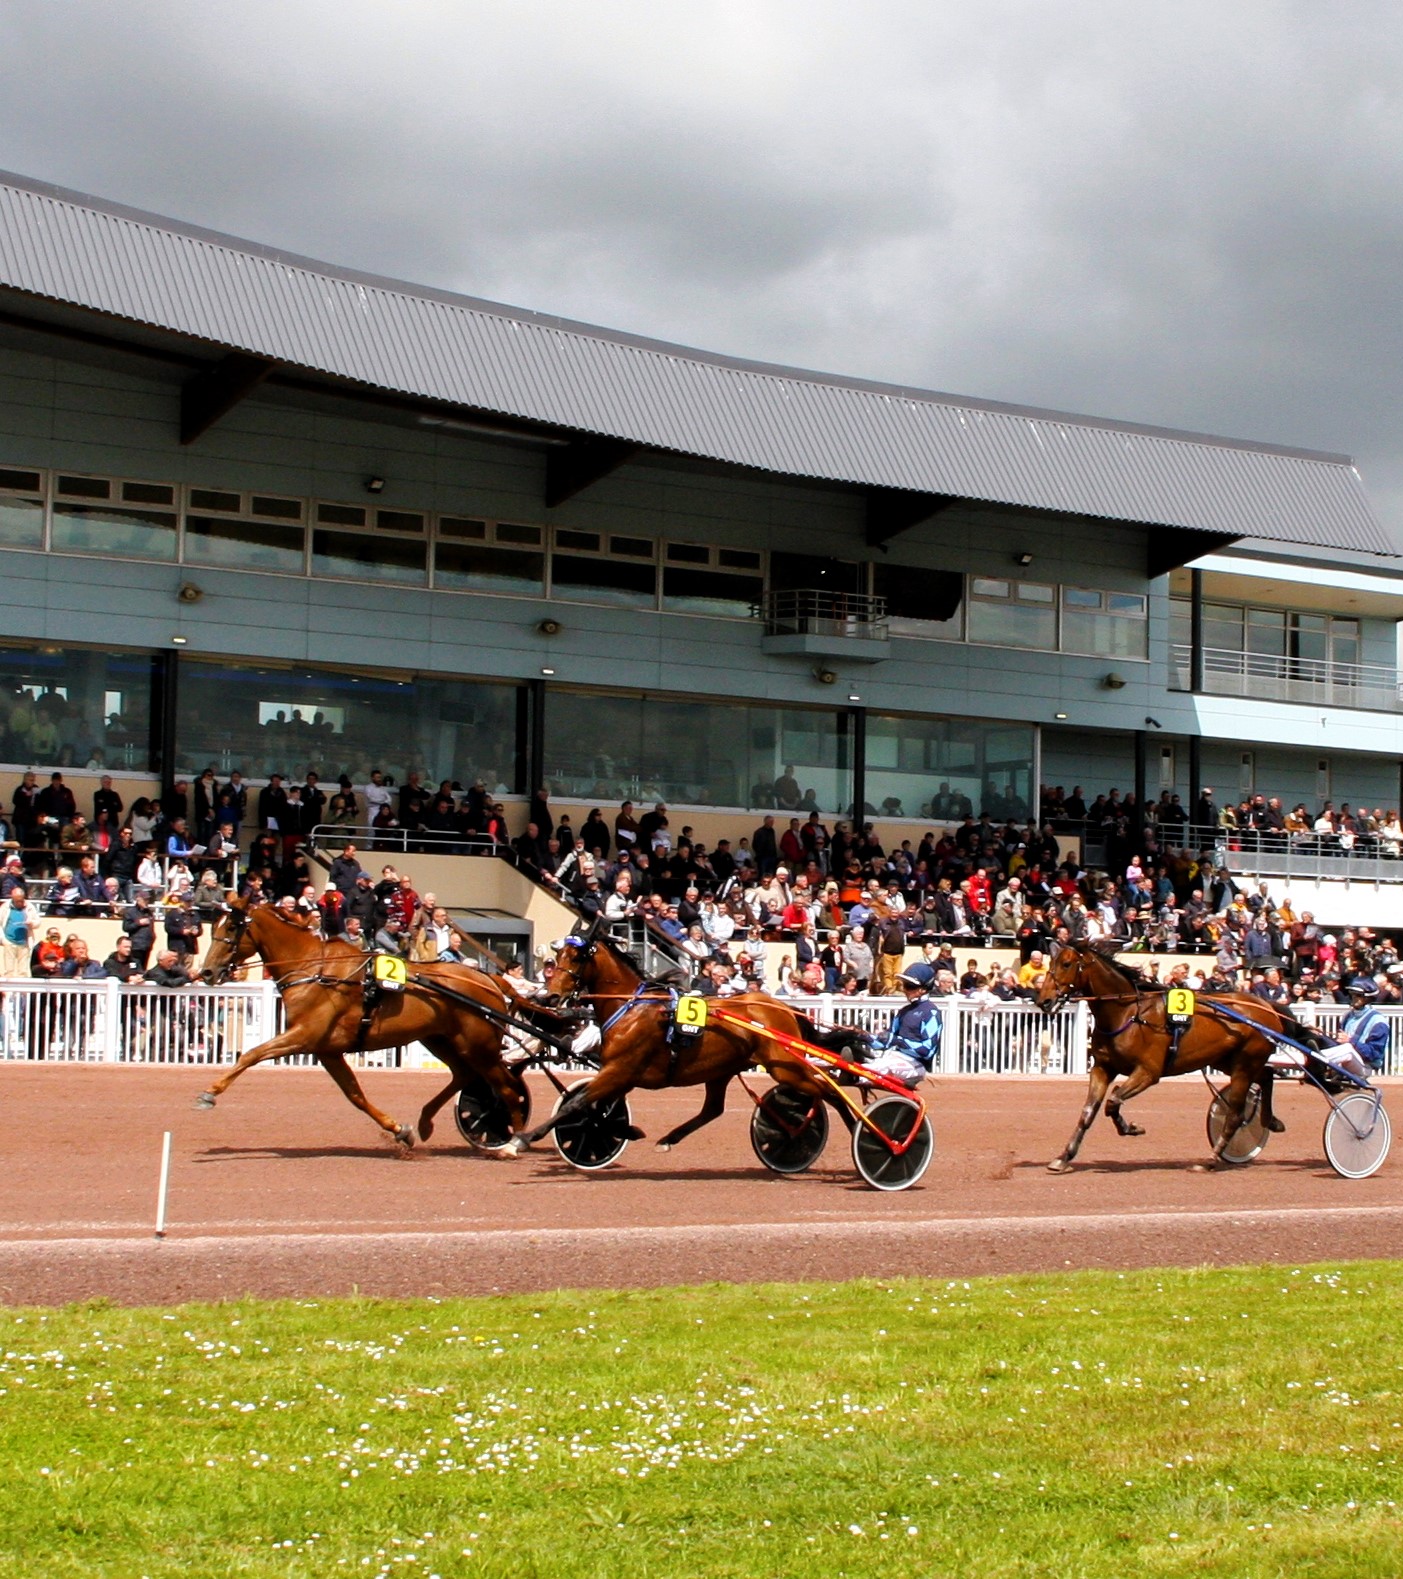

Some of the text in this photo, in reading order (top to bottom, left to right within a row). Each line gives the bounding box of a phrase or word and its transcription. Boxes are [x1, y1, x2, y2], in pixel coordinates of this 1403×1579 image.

[386, 959, 398, 980] 2
[687, 999, 699, 1022] 5
[1176, 992, 1187, 1012] 3
[681, 1024, 699, 1034] GNT
